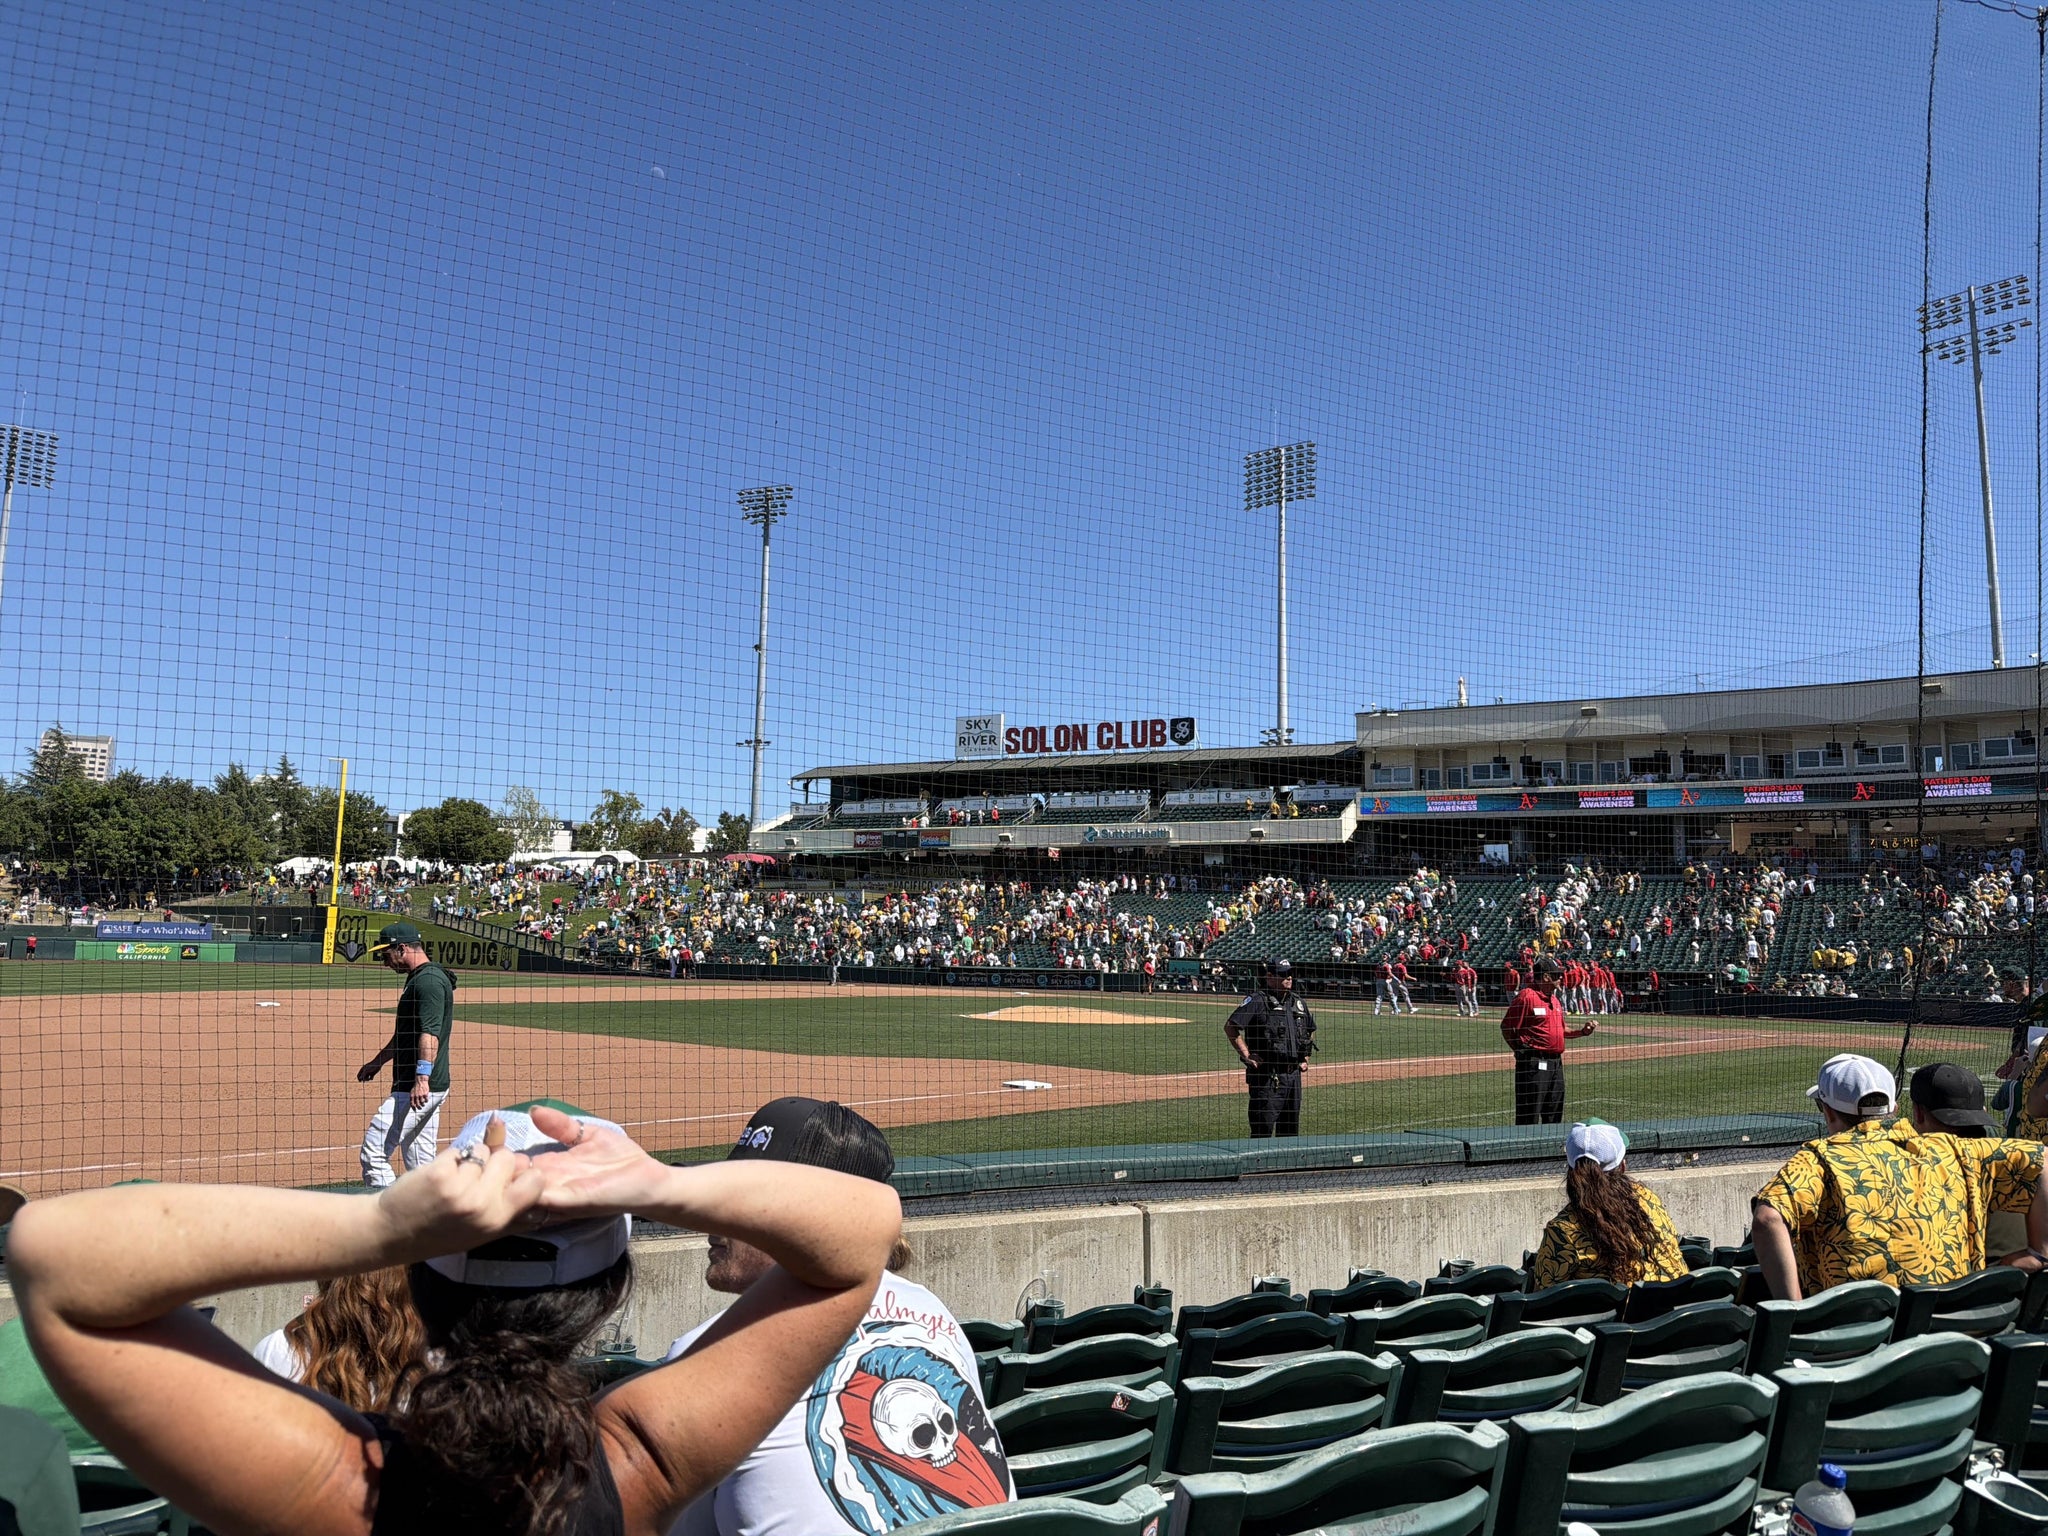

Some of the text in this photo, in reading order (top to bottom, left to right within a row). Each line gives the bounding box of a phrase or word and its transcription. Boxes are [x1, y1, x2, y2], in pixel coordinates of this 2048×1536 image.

[965, 719, 991, 730] SKY
[959, 735, 998, 746] RIVER
[1005, 718, 1167, 754] SOLON CLUB
[1924, 777, 1969, 785] FATHER'S
[1925, 787, 1992, 797] AWARENESS
[1579, 800, 1635, 808] AWARENESS
[1744, 796, 1804, 804] AWARENESS
[1101, 827, 1171, 839] Sutter Health
[894, 881, 933, 891] PACIFICO
[136, 926, 151, 934] For
[153, 927, 183, 935] What's
[185, 928, 207, 936] Next.
[337, 916, 367, 945] 811
[134, 943, 172, 955] Sports
[438, 942, 467, 965] YOU
[470, 942, 498, 967] DIG
